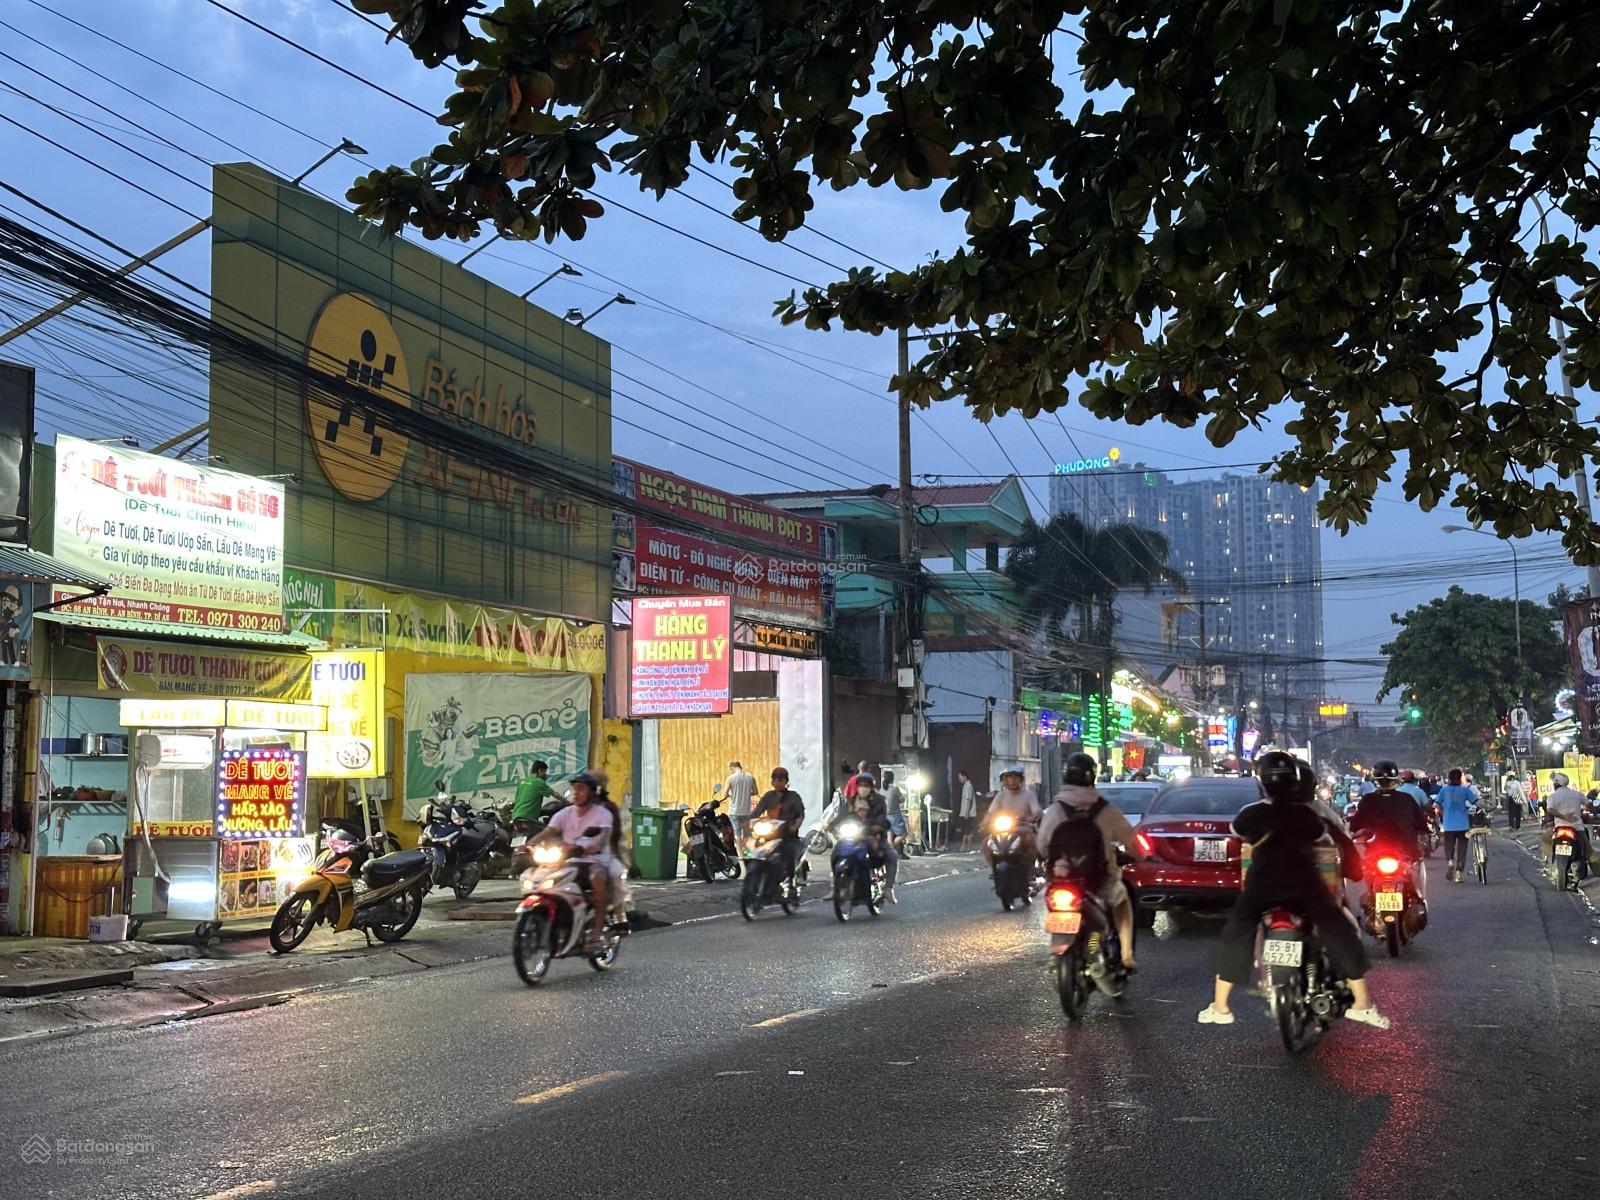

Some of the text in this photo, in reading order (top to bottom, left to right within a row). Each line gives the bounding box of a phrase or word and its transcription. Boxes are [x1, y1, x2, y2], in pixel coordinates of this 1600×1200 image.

[1055, 456, 1110, 474] PHUDONG
[639, 471, 688, 510] NGỌC
[690, 488, 727, 520] NAM
[778, 515, 803, 544] ĐẠT
[805, 523, 814, 545] 3
[103, 520, 116, 537] Dê
[143, 526, 155, 543] Dê
[158, 528, 176, 546] Tươi
[178, 531, 194, 553] Ướp
[233, 541, 243, 556] Dê
[245, 543, 265, 564] Mang
[103, 546, 119, 562] Gia
[121, 549, 130, 566] vị
[131, 550, 149, 570] ướp
[151, 553, 170, 569] theo
[172, 556, 187, 574] yêu
[226, 564, 234, 581] vị
[235, 564, 260, 581] Khách
[261, 568, 280, 587] Hàng
[640, 562, 667, 583] ĐIỆN
[693, 573, 720, 592] CÔNG
[142, 578, 153, 592] Đa
[153, 579, 172, 598] Dạng
[173, 581, 188, 596] Món
[208, 586, 218, 600] Dê
[245, 590, 255, 604] Dê
[82, 606, 91, 614] AN
[110, 608, 117, 617] P.
[117, 609, 126, 618] AN
[162, 613, 170, 622] AN
[127, 600, 148, 610] Nhanh
[149, 601, 170, 613] Chóng
[637, 598, 726, 610] Chuyên Mua Bán
[177, 607, 281, 632] TEL: 0971 300 240
[654, 610, 708, 637] HÀNG
[634, 639, 698, 662] THANH
[701, 633, 728, 661] LÝ
[132, 647, 155, 676] DÊ
[157, 651, 196, 678] TƯƠI
[199, 651, 250, 681] THÀNH
[329, 661, 366, 681] TƯƠI
[174, 682, 198, 694] MANG
[225, 756, 296, 780] DÊ TƯƠI
[476, 753, 498, 785] 2
[223, 781, 294, 800] MANG VỀ
[260, 801, 286, 817] XÀO
[165, 823, 214, 837] TƯƠI
[1202, 841, 1220, 851] 51H
